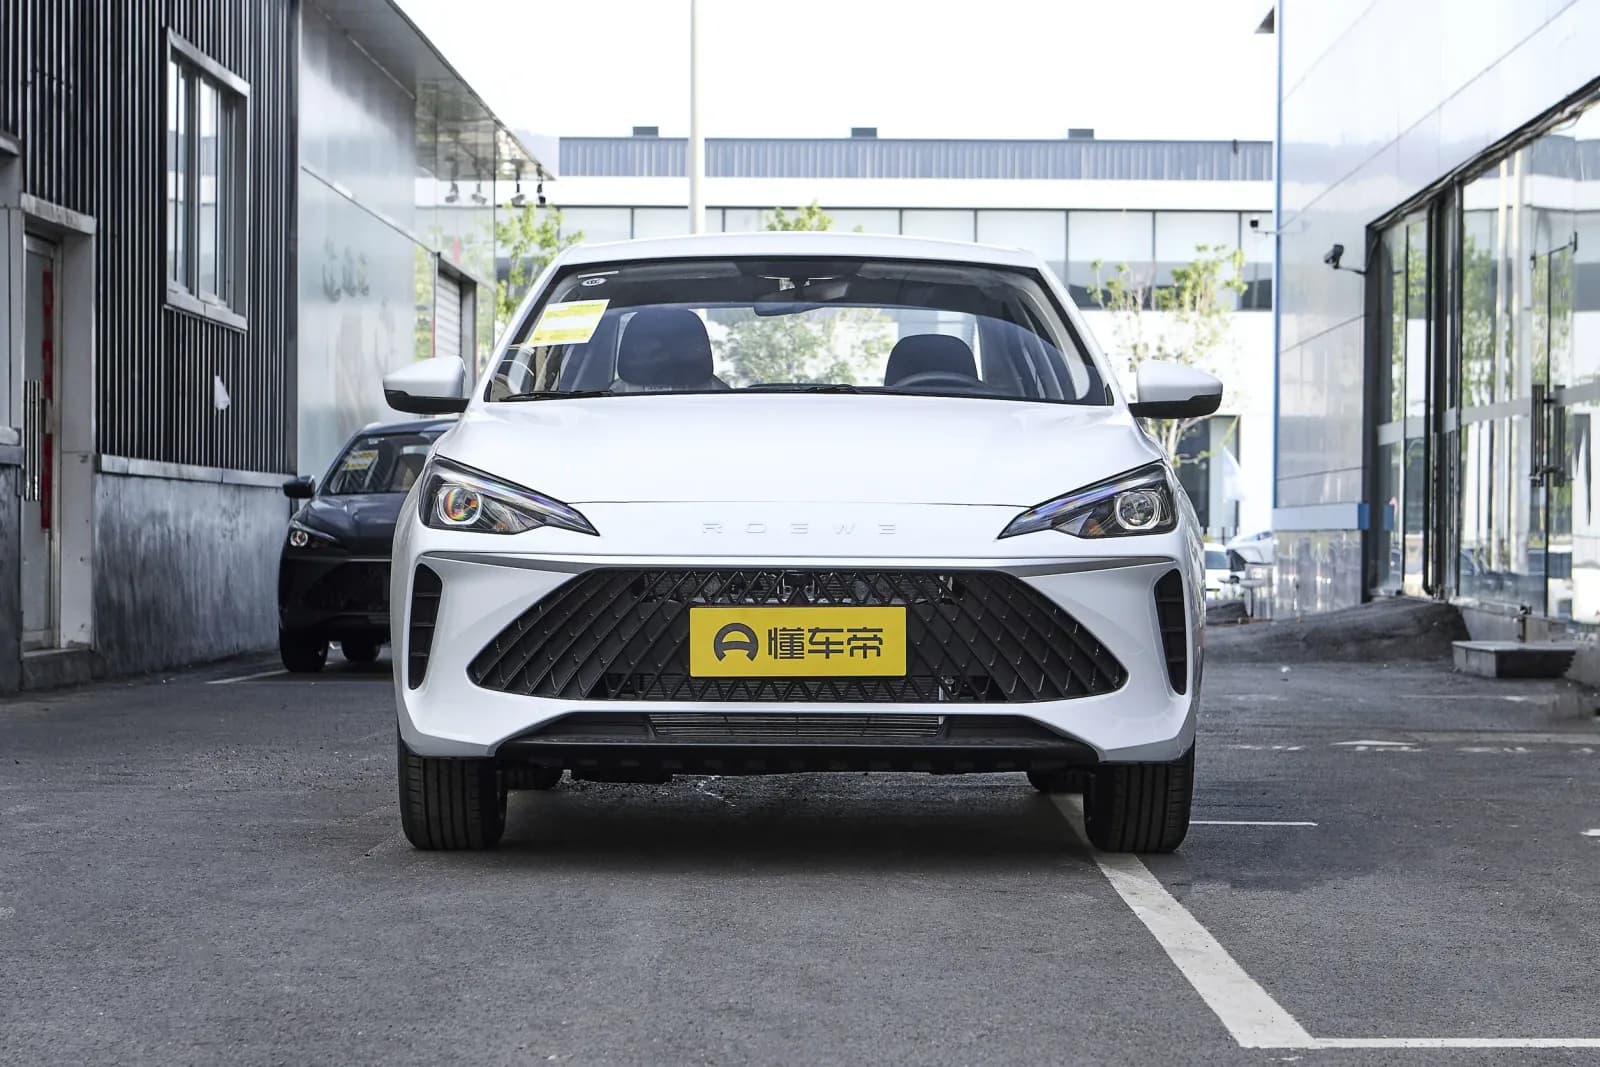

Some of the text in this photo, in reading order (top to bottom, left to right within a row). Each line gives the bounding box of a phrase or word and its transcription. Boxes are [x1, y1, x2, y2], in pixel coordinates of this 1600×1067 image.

[703, 523, 897, 535] ROEWE
[767, 627, 884, 660] 懂车帝
